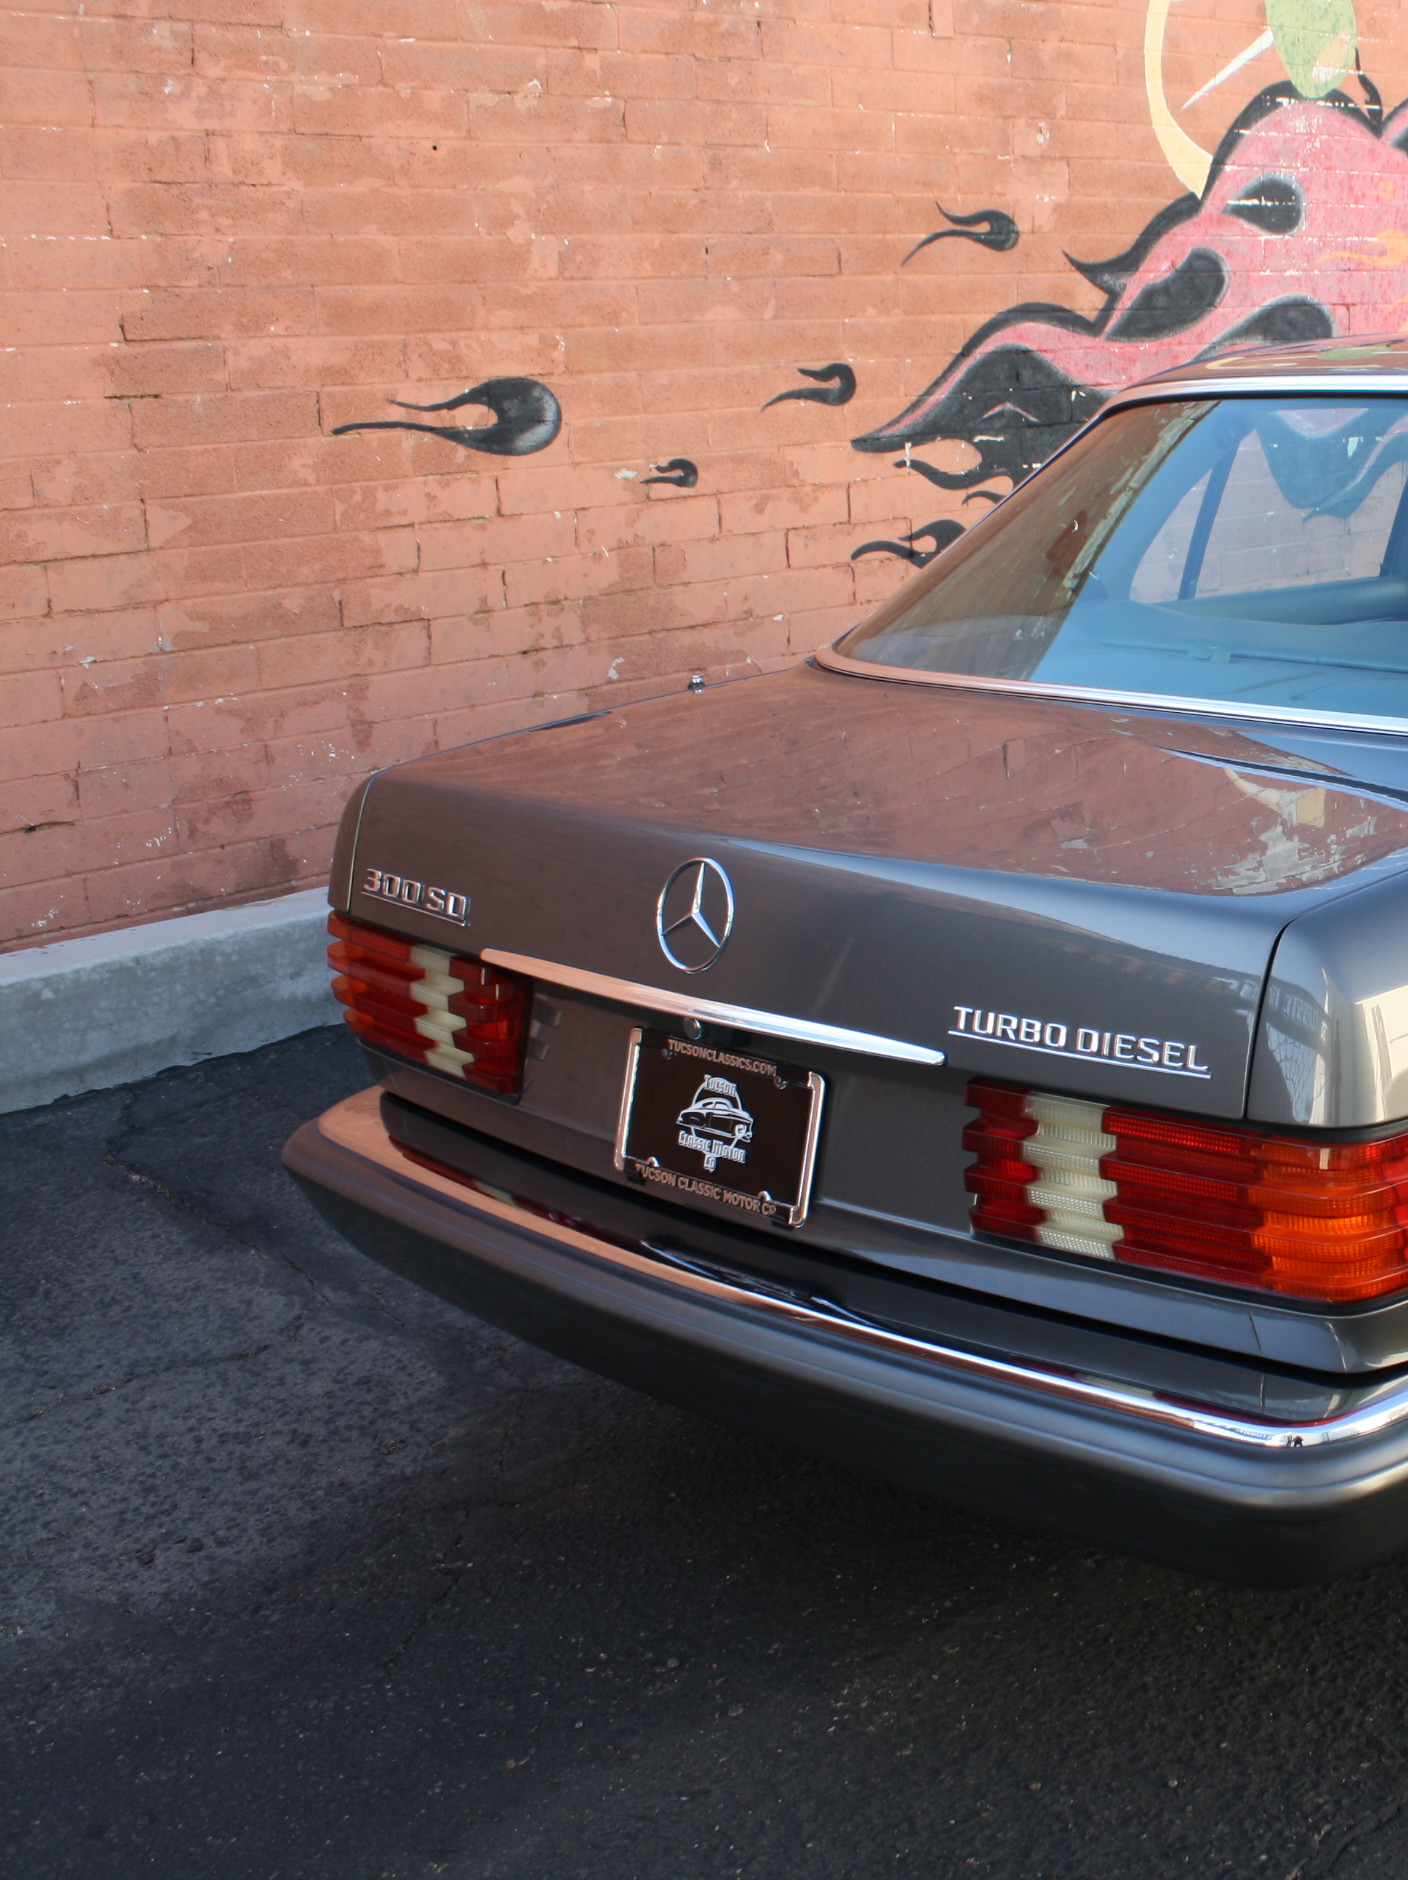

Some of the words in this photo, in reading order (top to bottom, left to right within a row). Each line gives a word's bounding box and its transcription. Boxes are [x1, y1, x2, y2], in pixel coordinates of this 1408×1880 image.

[362, 867, 425, 906] 300
[426, 886, 471, 922] SD
[667, 1038, 778, 1077] TUCSONCLASSICS.COM
[953, 1005, 1067, 1049] TURBO
[1075, 1027, 1210, 1072] DIESEL
[634, 1162, 677, 1188] TUCSON
[677, 1176, 722, 1201] CLASSIC
[722, 1189, 761, 1212] MOTOR
